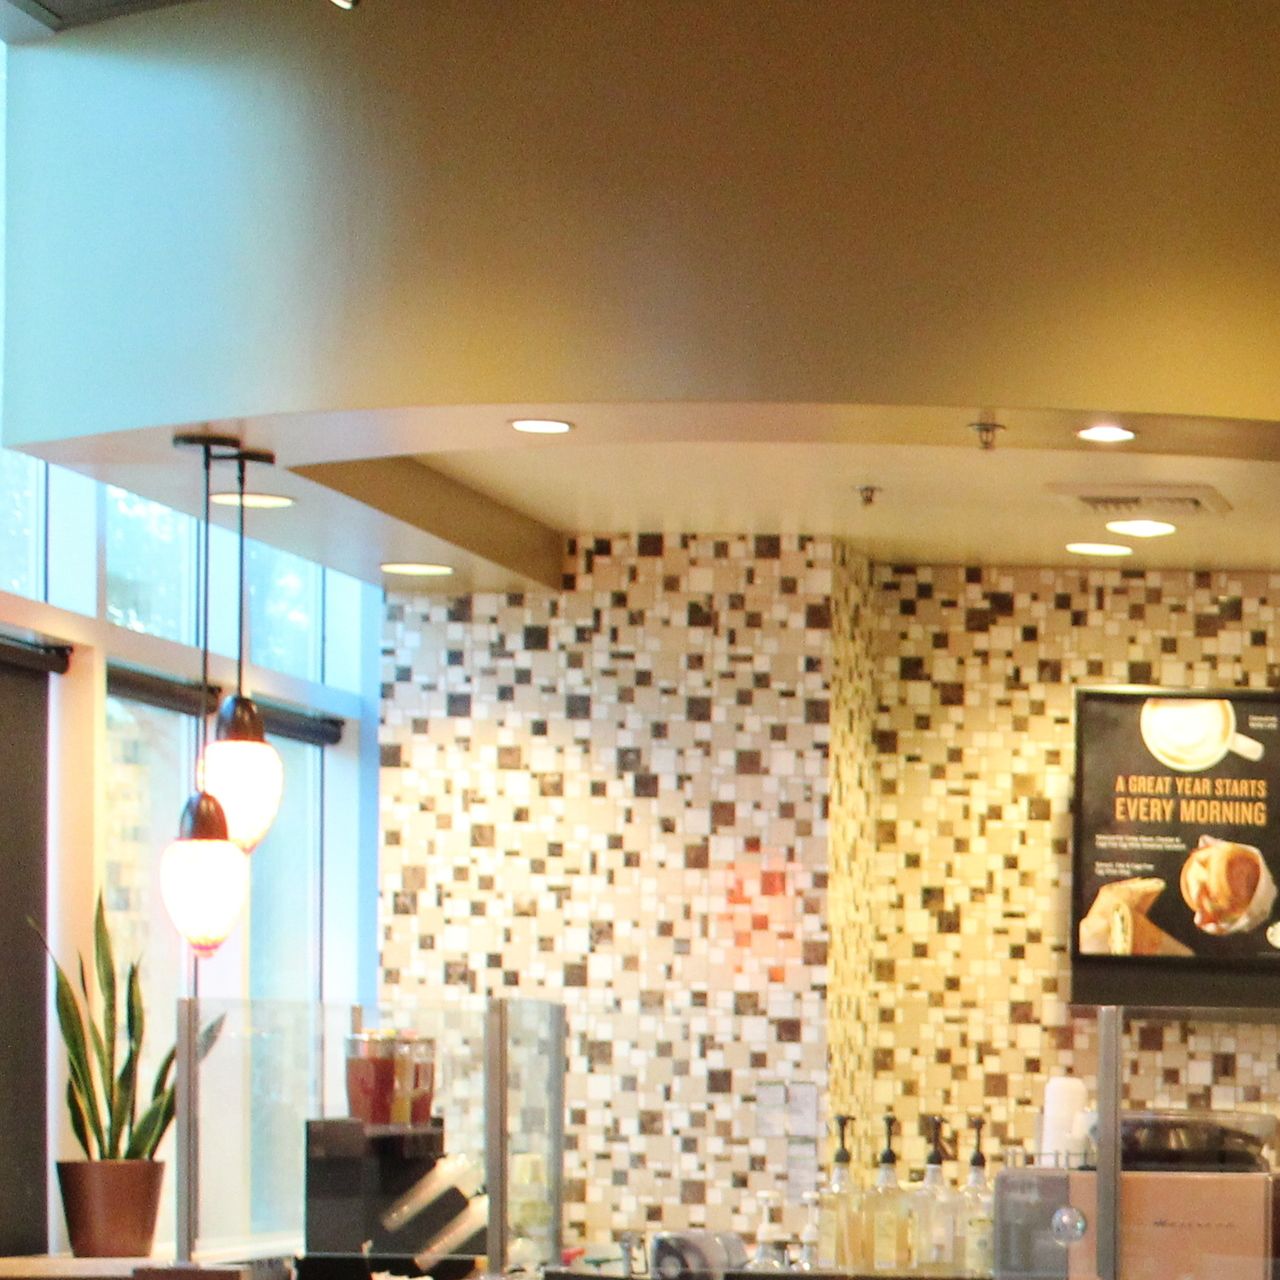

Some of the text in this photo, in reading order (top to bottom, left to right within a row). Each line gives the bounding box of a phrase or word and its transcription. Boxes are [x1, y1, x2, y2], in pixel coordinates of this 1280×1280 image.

[1115, 775, 1266, 798] A GREAT YEAR STARTS
[1115, 797, 1266, 826] EVERY MORNING
